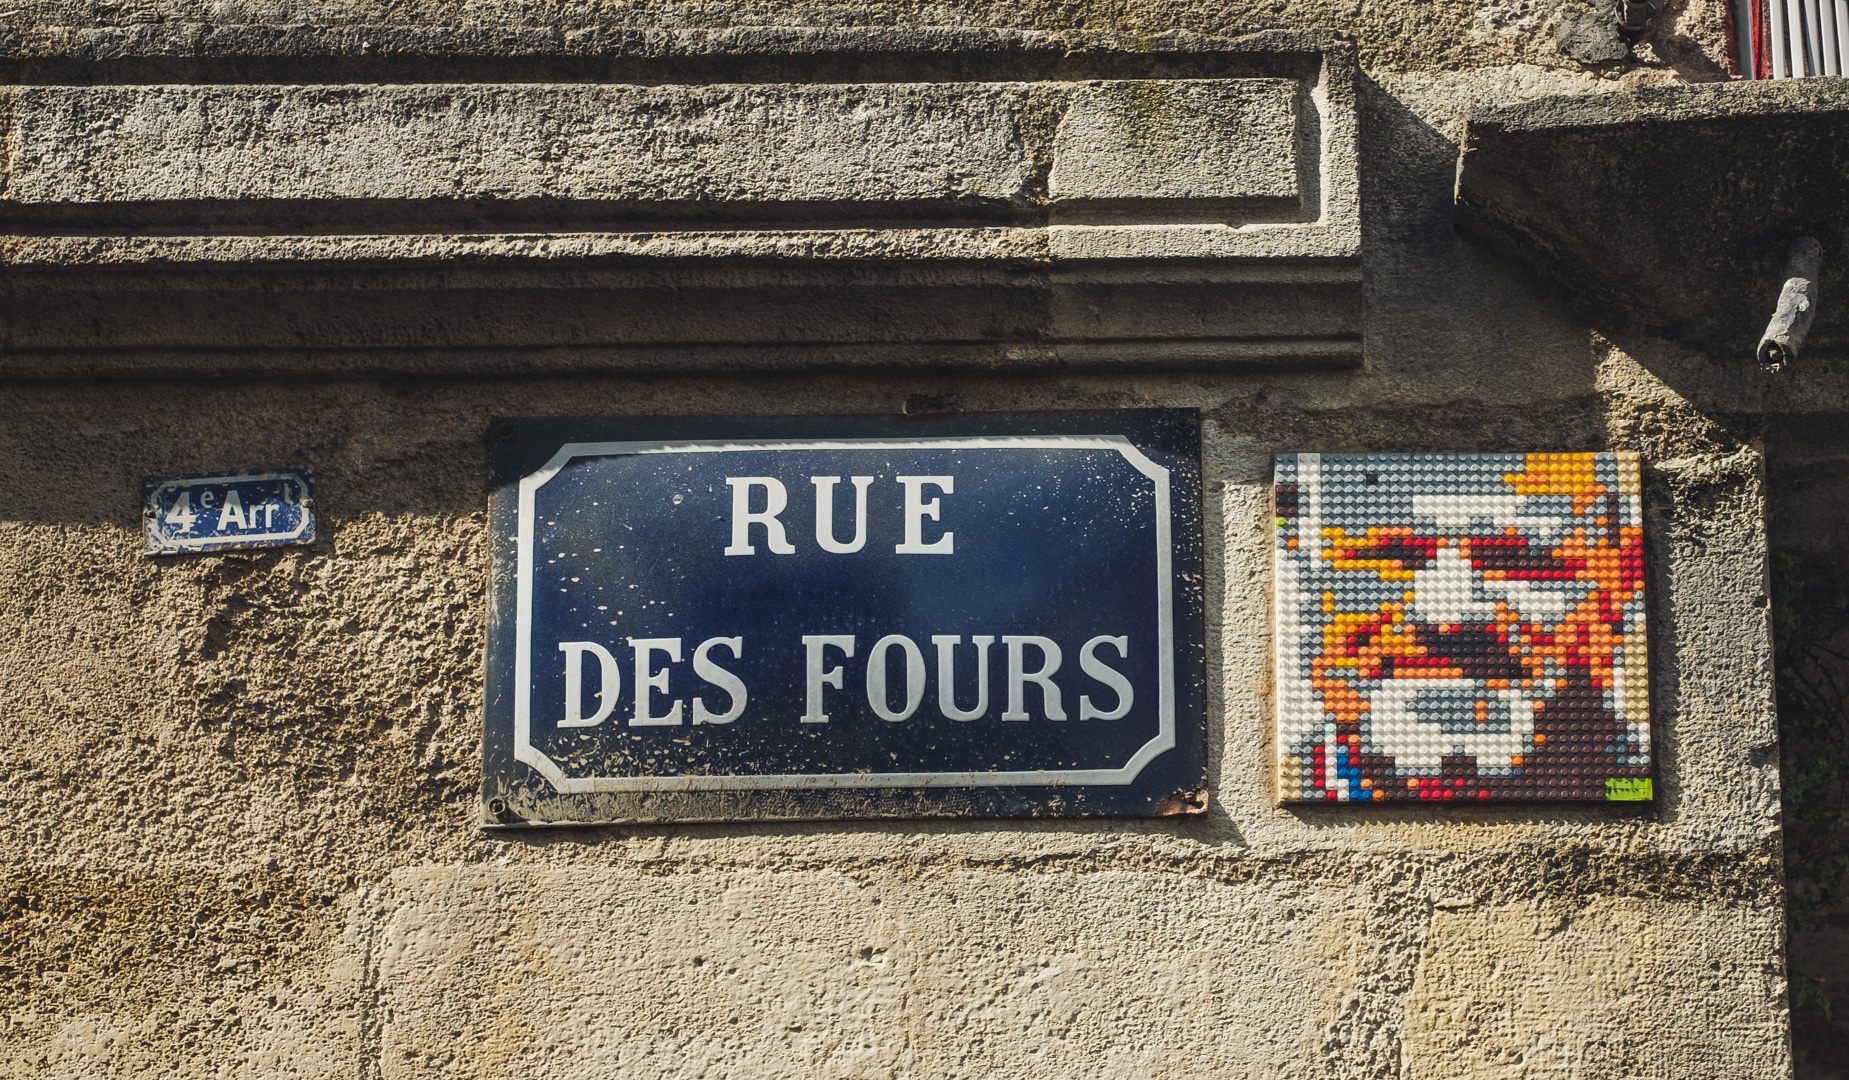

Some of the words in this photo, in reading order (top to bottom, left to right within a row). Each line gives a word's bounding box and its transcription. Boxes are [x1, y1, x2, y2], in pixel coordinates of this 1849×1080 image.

[724, 474, 955, 557] RUE
[556, 635, 749, 729] DES
[799, 634, 1135, 724] FOURS
